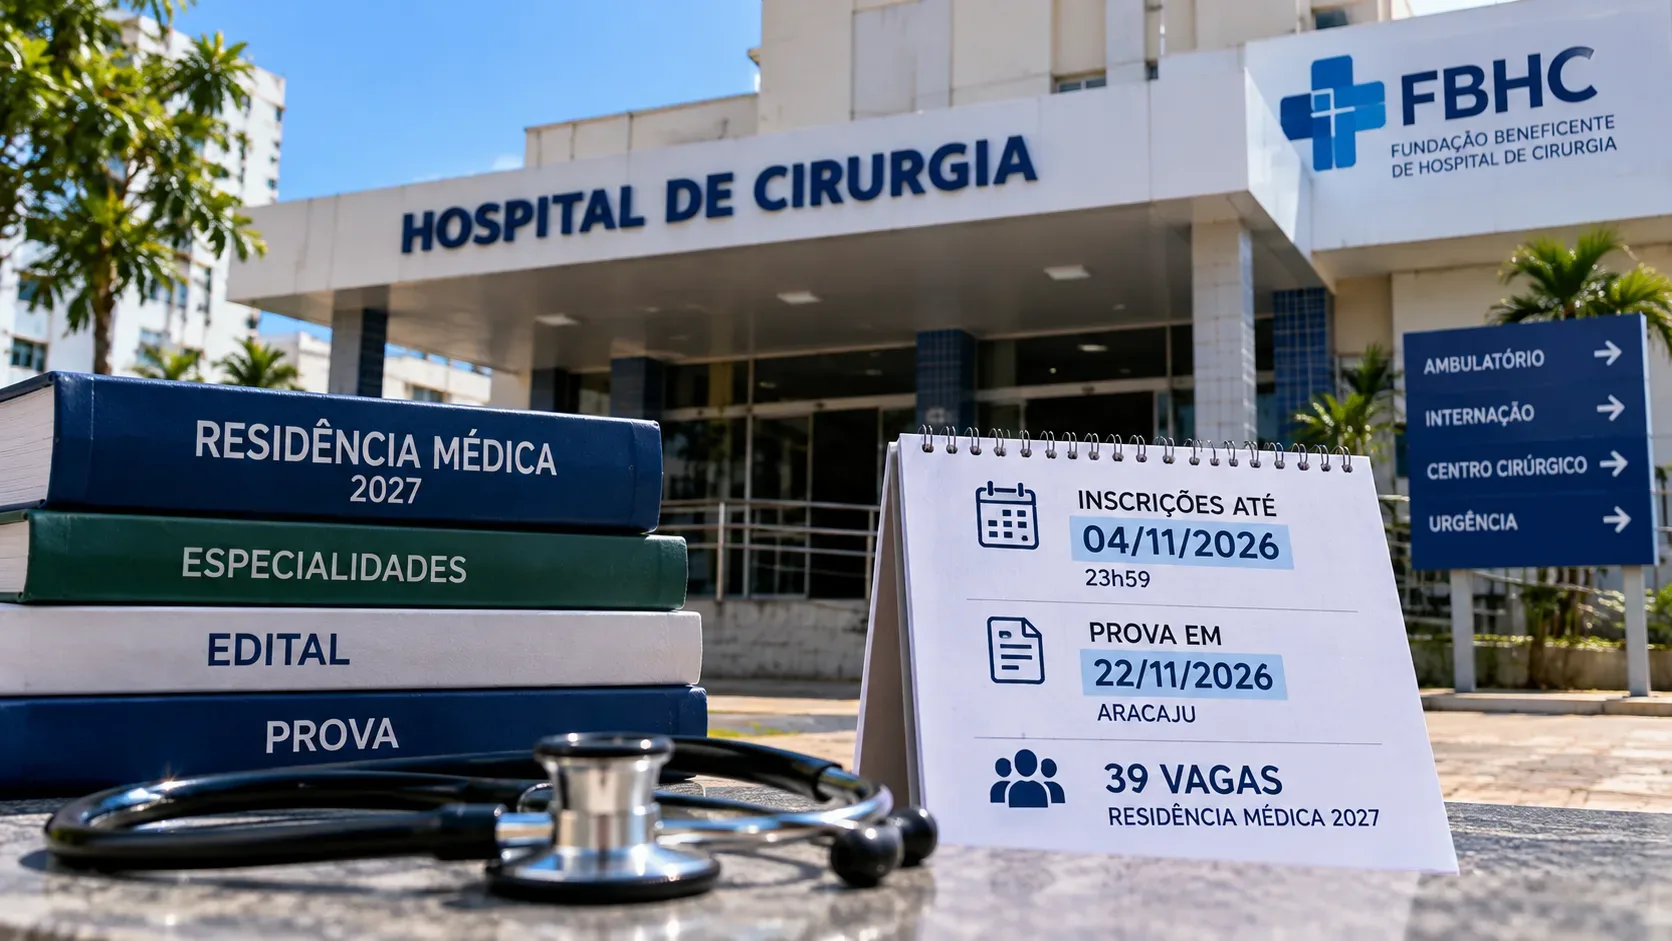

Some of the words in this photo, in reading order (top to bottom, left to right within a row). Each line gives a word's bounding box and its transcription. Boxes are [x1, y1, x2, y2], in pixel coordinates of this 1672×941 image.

[1402, 46, 1598, 126] FBHC
[1392, 131, 1488, 158] FUNDAÇÃO
[1495, 115, 1615, 144] BENEFICENTE
[1392, 163, 1413, 178] DE
[1418, 152, 1498, 174] HOSPITAL
[1504, 148, 1526, 165] DE
[1532, 136, 1617, 160] CIRURGIA
[402, 186, 645, 254] HOSPITAL
[666, 173, 733, 223] DE
[754, 136, 1038, 212] CIRURGIA
[1424, 348, 1544, 374] AMBULATÓRIO
[1426, 401, 1534, 426] INTERNAÇÃO
[196, 419, 420, 468] RESIDÊNCIA
[434, 429, 557, 475] MÉDICA
[1427, 461, 1492, 479] CENTRO
[1497, 455, 1587, 477] CIRÚRGICO
[350, 475, 421, 503] 2027
[1079, 490, 1224, 517] INSCRIÇÕES
[1233, 493, 1276, 516] ATÉ
[1429, 510, 1518, 532] URGÊNCIA
[1084, 525, 1279, 560] 04/11/2026
[183, 547, 466, 583] ESPECIALIDADES
[1086, 569, 1150, 587] 23h59
[1090, 622, 1177, 644] PROVA
[1185, 625, 1221, 645] EM
[208, 633, 350, 666] EDITAL
[1094, 659, 1272, 690] 22/11/2026
[1098, 704, 1195, 723] ARACAJU
[266, 718, 399, 753] PROVA
[1105, 763, 1148, 793] 39
[1160, 764, 1282, 795] VAGAS
[1109, 803, 1237, 826] RESIDÊNCIA
[1244, 804, 1325, 826] MÉDICA
[1331, 809, 1379, 826] 2027
